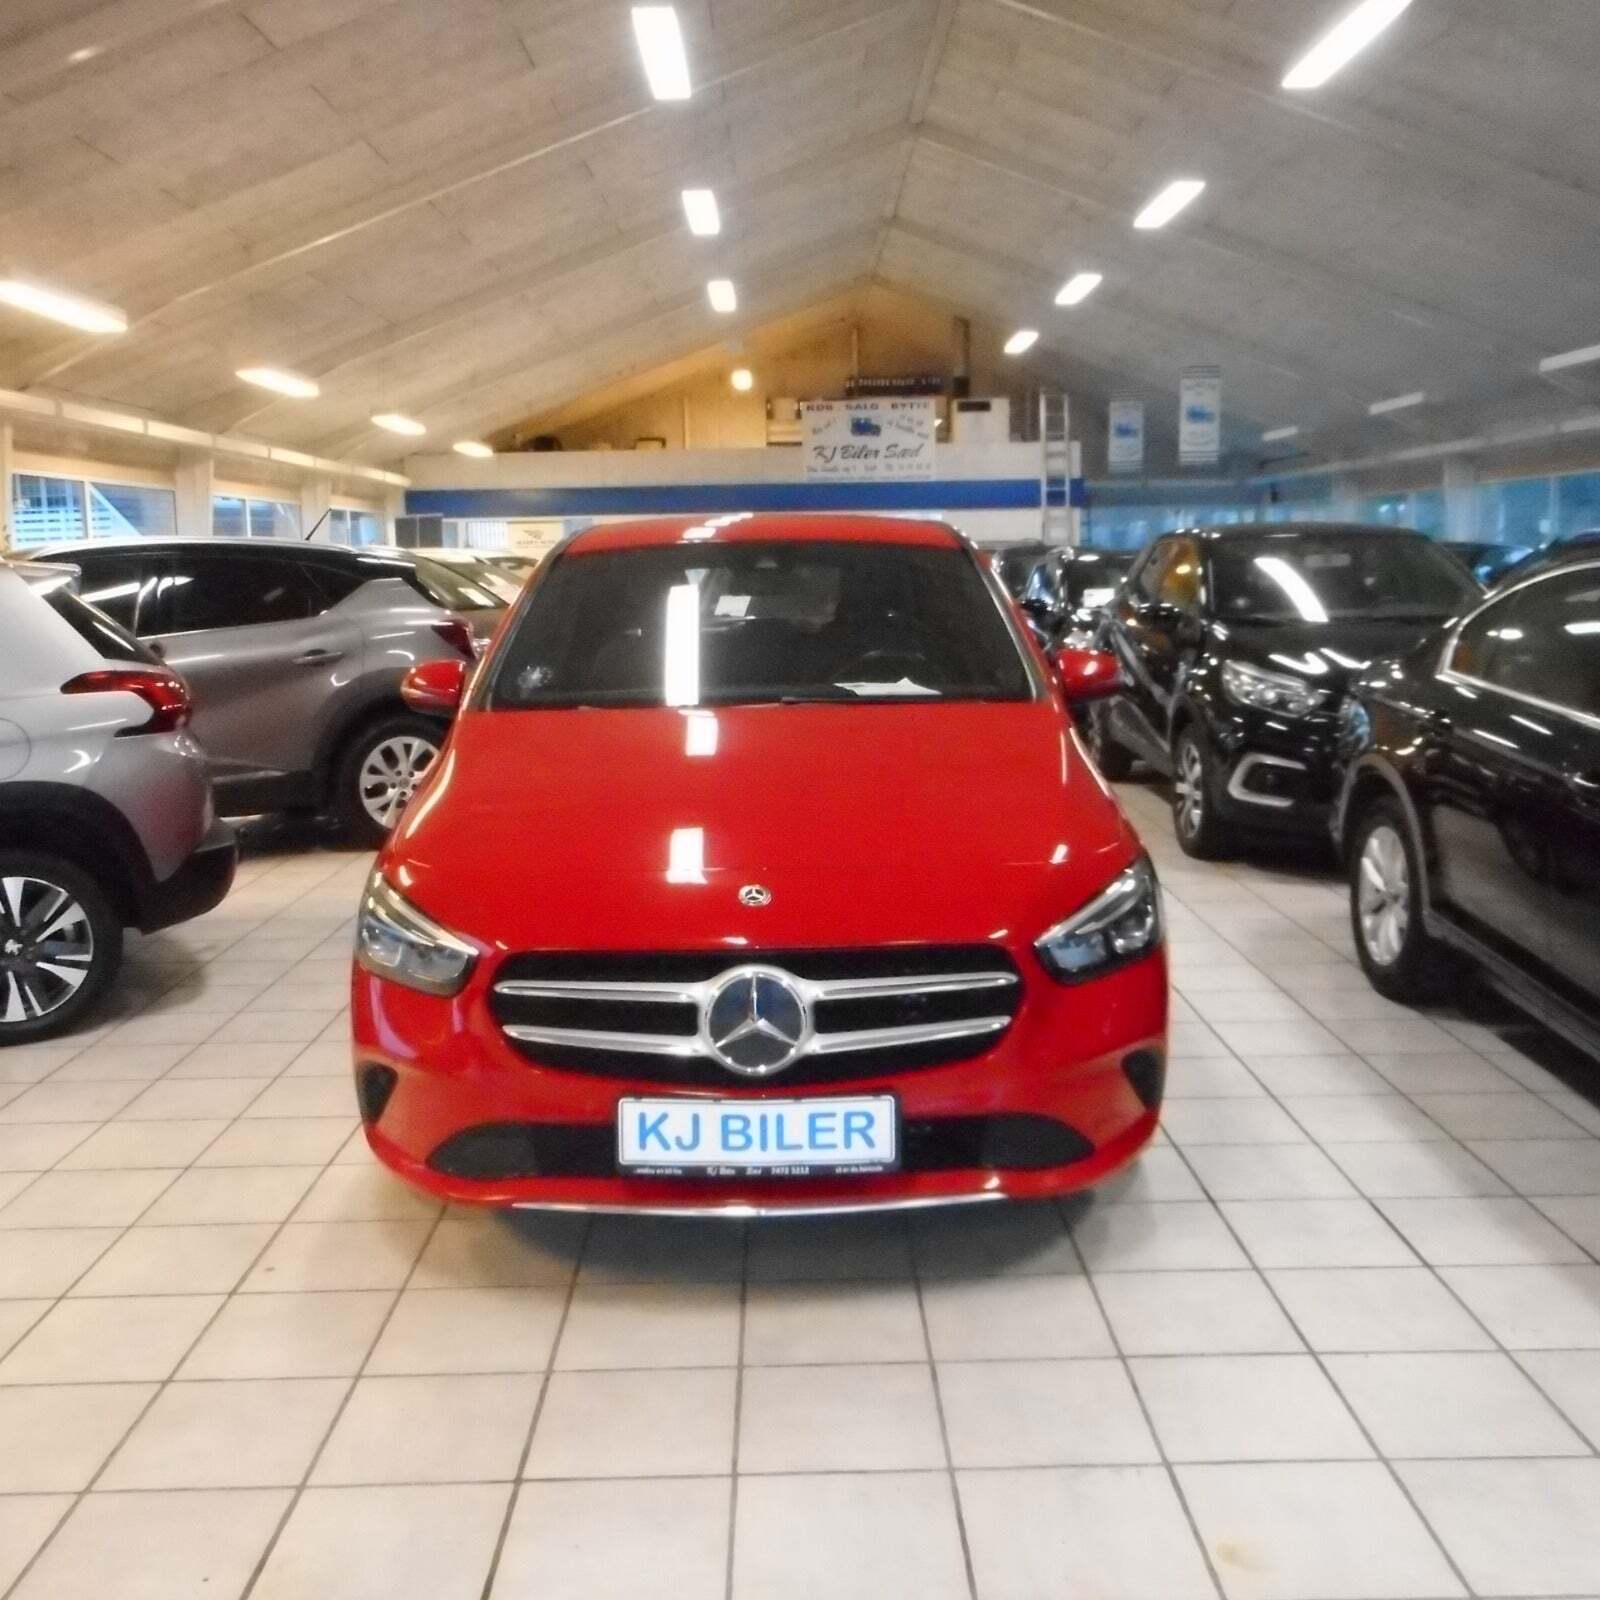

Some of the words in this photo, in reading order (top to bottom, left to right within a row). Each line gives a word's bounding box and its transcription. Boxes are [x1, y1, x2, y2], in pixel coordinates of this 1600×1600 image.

[841, 444, 880, 460] Biler
[638, 1112, 700, 1151] KJ
[721, 1111, 876, 1152] BILER
